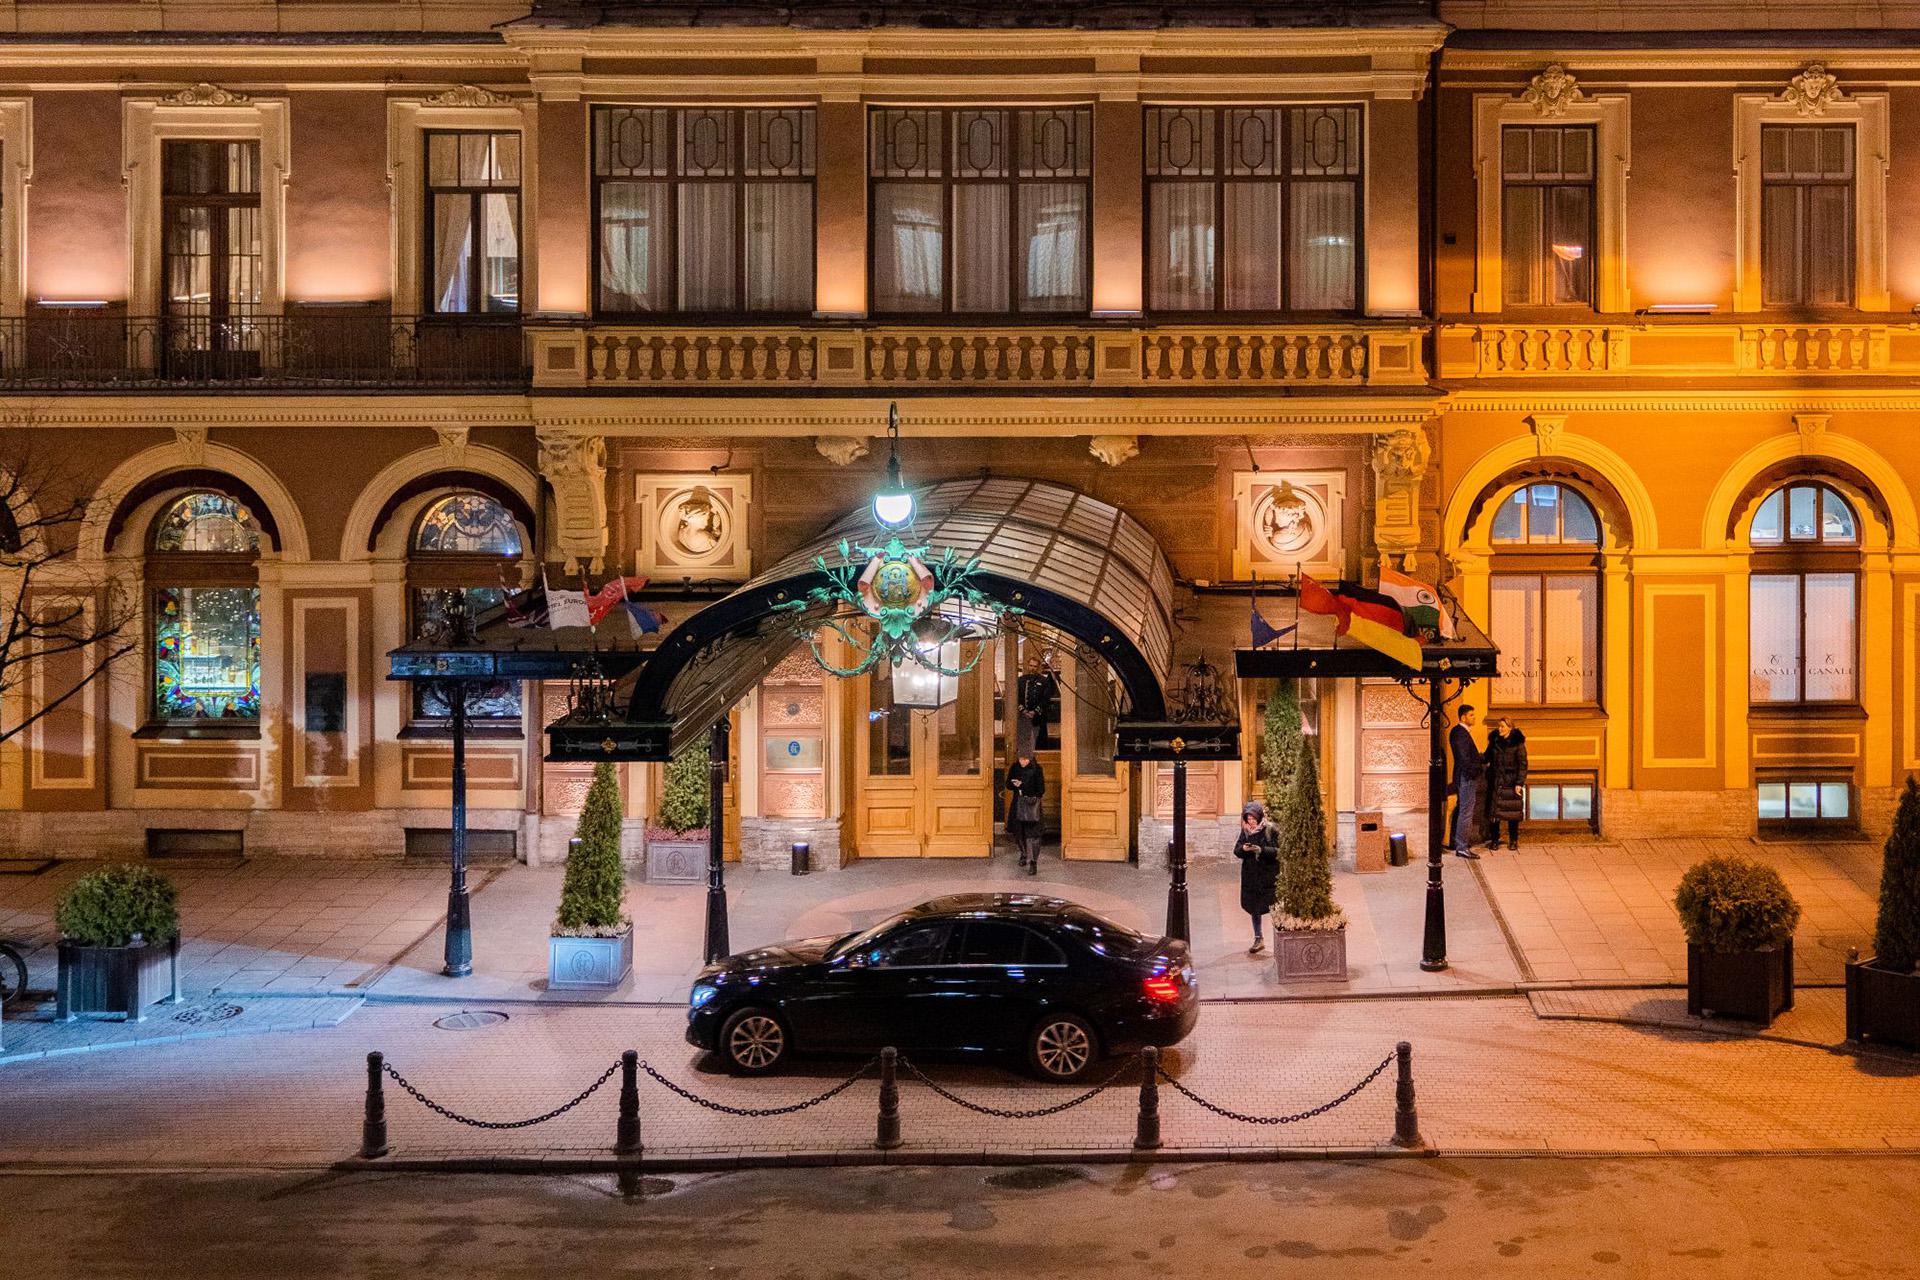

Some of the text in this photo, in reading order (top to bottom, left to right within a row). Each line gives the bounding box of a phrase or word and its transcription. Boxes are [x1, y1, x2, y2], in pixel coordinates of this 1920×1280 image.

[1503, 670, 1538, 678] ANALI
[1550, 670, 1593, 678] CANALI
[1754, 667, 1797, 675] CANALI
[1808, 667, 1852, 675] CANALI
